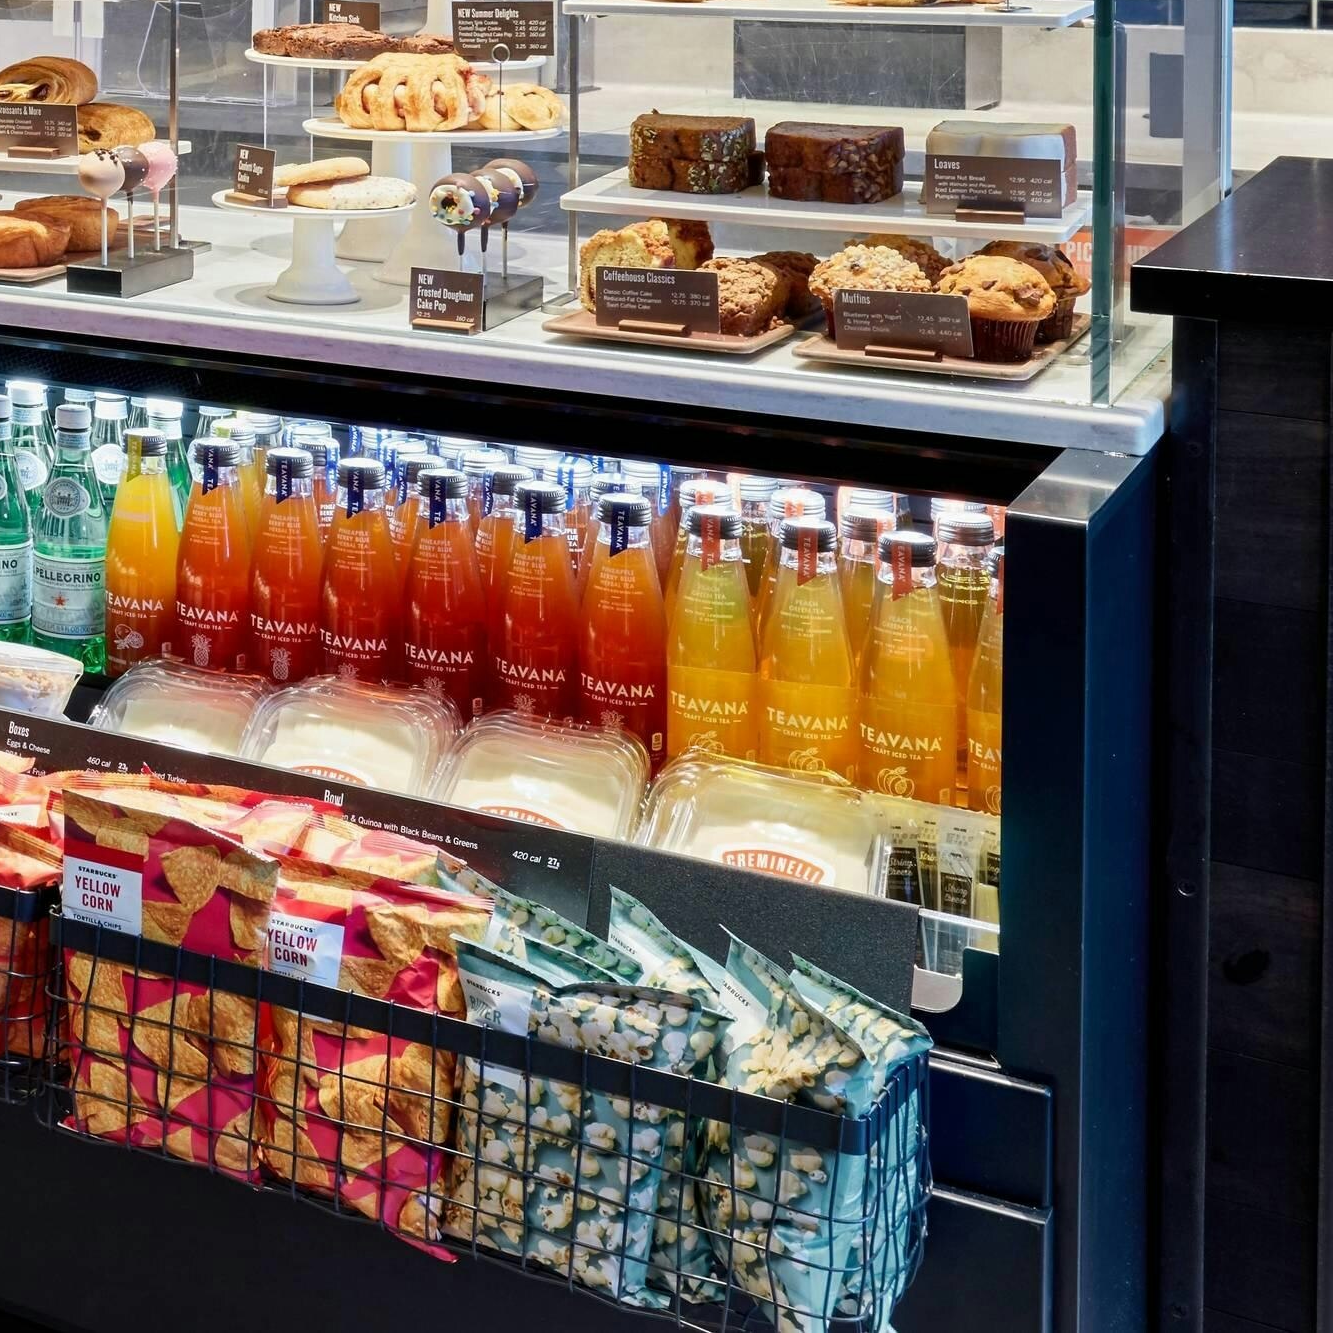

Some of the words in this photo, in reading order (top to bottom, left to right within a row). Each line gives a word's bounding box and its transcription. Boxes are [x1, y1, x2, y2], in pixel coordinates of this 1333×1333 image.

[458, 9, 470, 18] NEW
[471, 9, 494, 18] Summer
[495, 9, 519, 20] Delights
[23, 106, 27, 115] &
[29, 106, 41, 116] More
[934, 158, 960, 169] Loaves
[418, 274, 433, 285] NEW
[603, 270, 645, 283] Coffeehouse
[647, 273, 675, 284] Classics
[417, 298, 432, 310] Cake
[434, 301, 446, 313] Pop
[418, 286, 441, 299] Frosted
[443, 289, 473, 303] Doughnut
[842, 292, 871, 305] Muffins
[105, 590, 165, 612] TEAVANA
[176, 600, 239, 623] TEAVANA
[250, 614, 317, 636] TEAVANA
[319, 628, 387, 652] TEAVANA
[405, 642, 474, 664] TEAVANA
[495, 657, 566, 682] TEAVANA
[581, 672, 655, 698] TEAVANA
[670, 691, 749, 716] TEAVANA
[9, 721, 29, 737] Boxes
[767, 706, 848, 731] TEAVANA
[859, 723, 942, 752] TEAVANA
[324, 789, 344, 807] Bowl
[350, 814, 357, 823] &
[357, 815, 382, 829] Quinoa
[383, 820, 398, 832] with
[400, 824, 420, 838] Black
[421, 829, 443, 842] Beans
[445, 835, 452, 843] &
[453, 836, 478, 850] Greens
[78, 866, 117, 879] STARBUCKS
[726, 852, 822, 885] CREMINELLI
[75, 875, 121, 898] YELLOW
[82, 893, 113, 912] CORN
[267, 928, 317, 952] YELLOW
[275, 947, 307, 966] CORN
